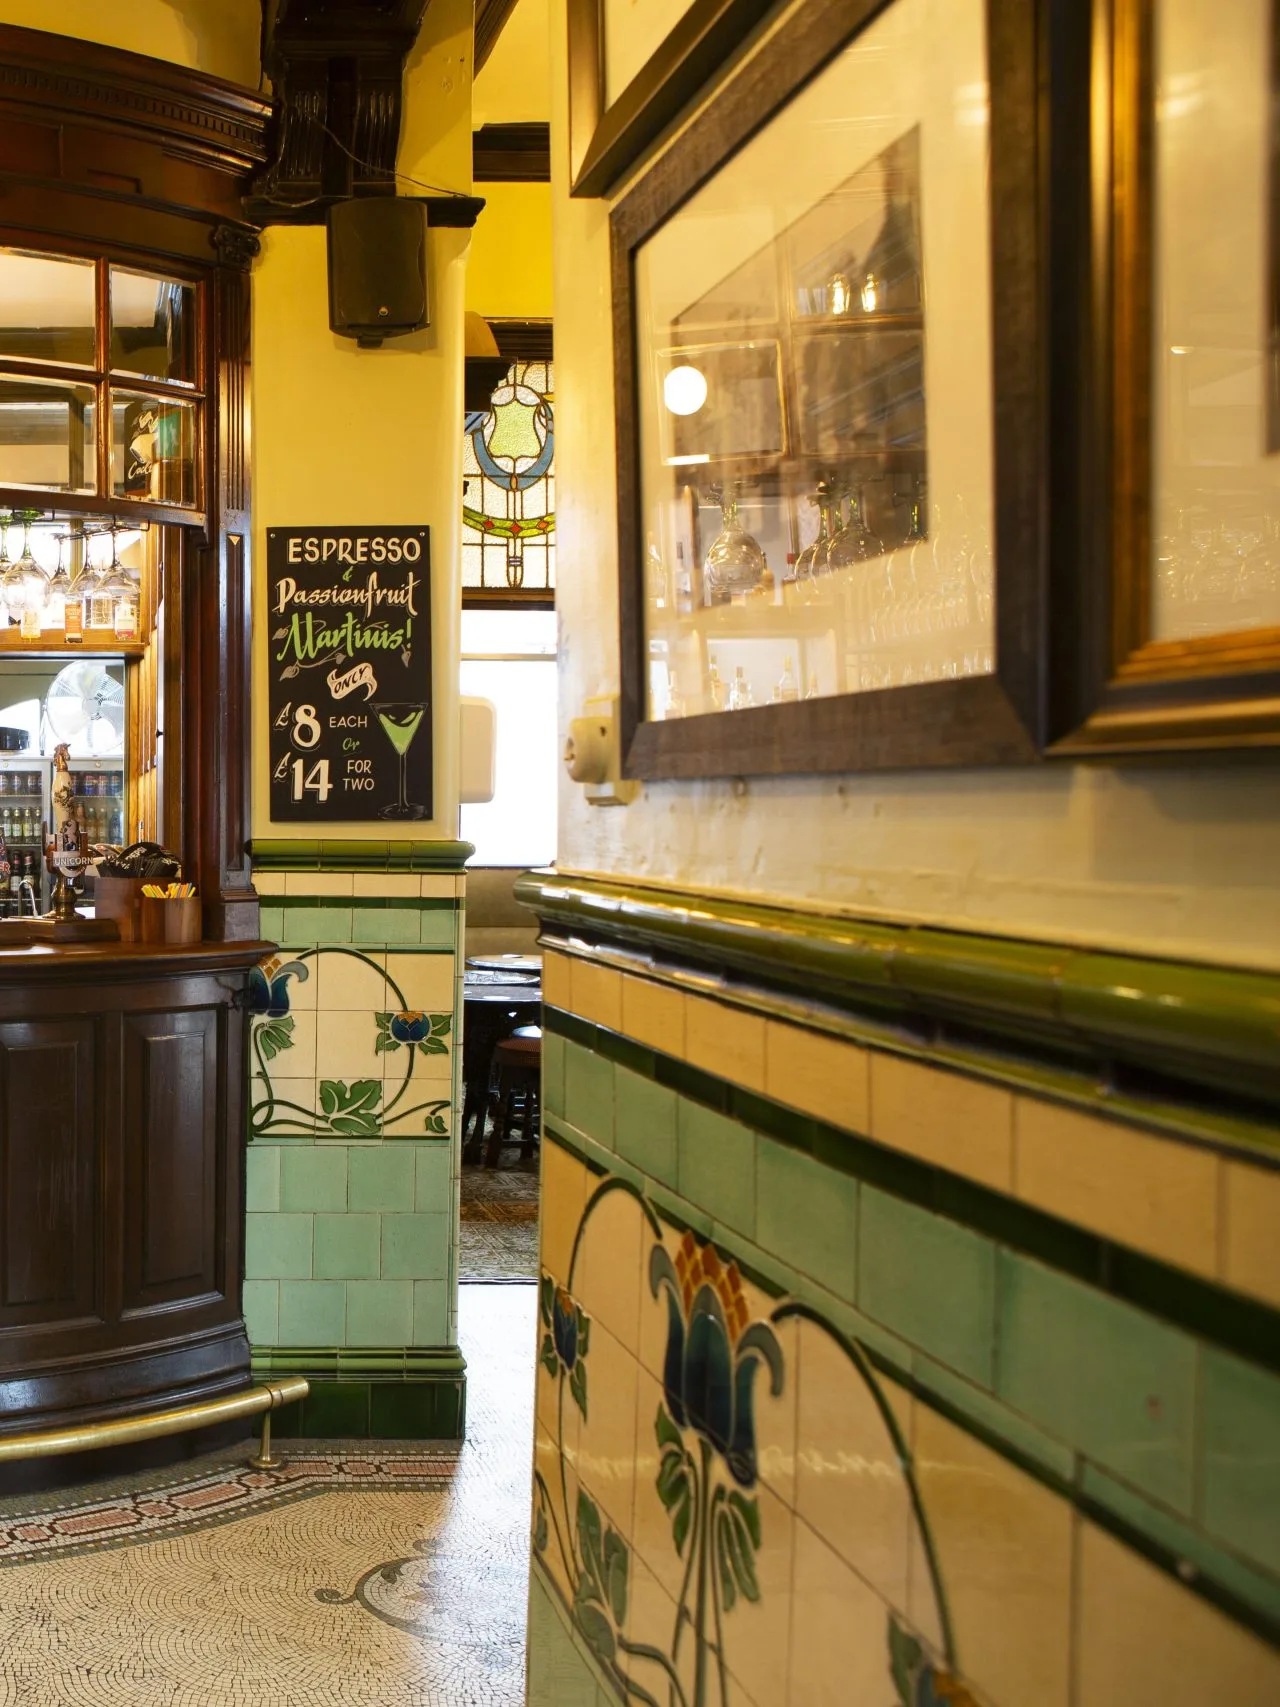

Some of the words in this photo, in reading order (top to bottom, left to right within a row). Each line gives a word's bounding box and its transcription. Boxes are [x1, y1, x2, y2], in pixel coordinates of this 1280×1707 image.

[287, 536, 422, 564] ESPRESSO
[271, 571, 422, 618] Passionfruit
[276, 611, 412, 661] Martinis!
[334, 666, 369, 694] ONLY
[275, 702, 321, 748] £8
[329, 715, 368, 729] EACH
[274, 752, 334, 802] £14
[346, 759, 372, 774] FOR
[342, 778, 375, 791] TWO
[54, 856, 94, 866] UNICORN
